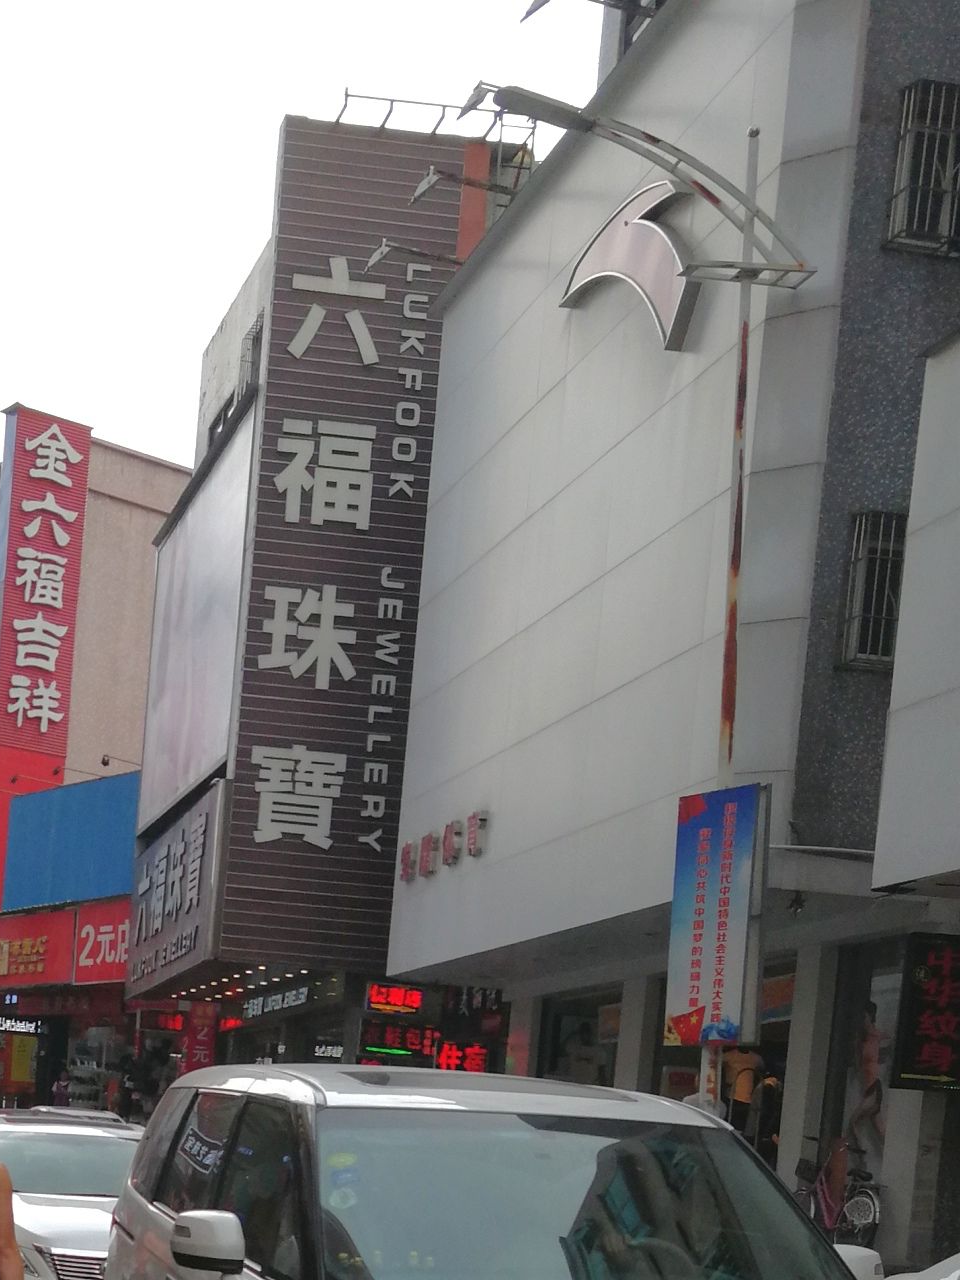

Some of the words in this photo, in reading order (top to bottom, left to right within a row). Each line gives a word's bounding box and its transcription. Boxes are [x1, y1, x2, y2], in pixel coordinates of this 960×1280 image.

[388, 262, 432, 498] LUKFOOK
[7, 423, 83, 732] 金六福吉祥
[251, 256, 386, 851] 六福珠寶
[358, 566, 405, 852] JEWELLERY
